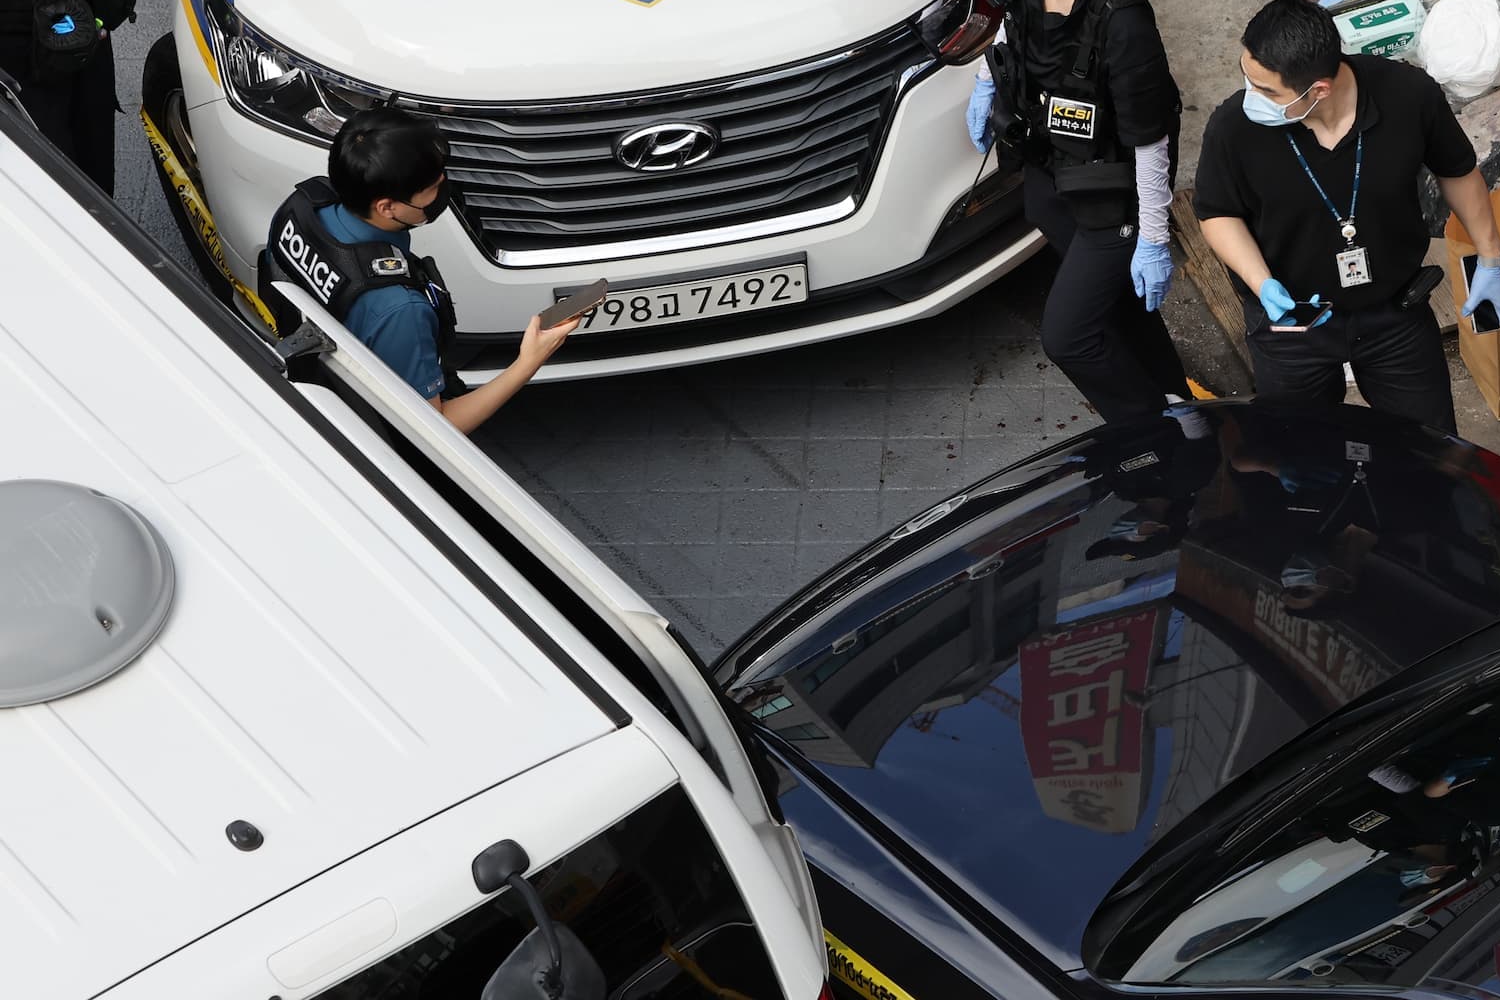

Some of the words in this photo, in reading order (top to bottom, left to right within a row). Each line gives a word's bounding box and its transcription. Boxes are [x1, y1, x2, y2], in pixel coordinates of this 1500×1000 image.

[1052, 117, 1091, 133] 과학수사
[1053, 104, 1091, 121] KCSI
[280, 219, 340, 301] POLICE
[691, 273, 791, 314] 7492
